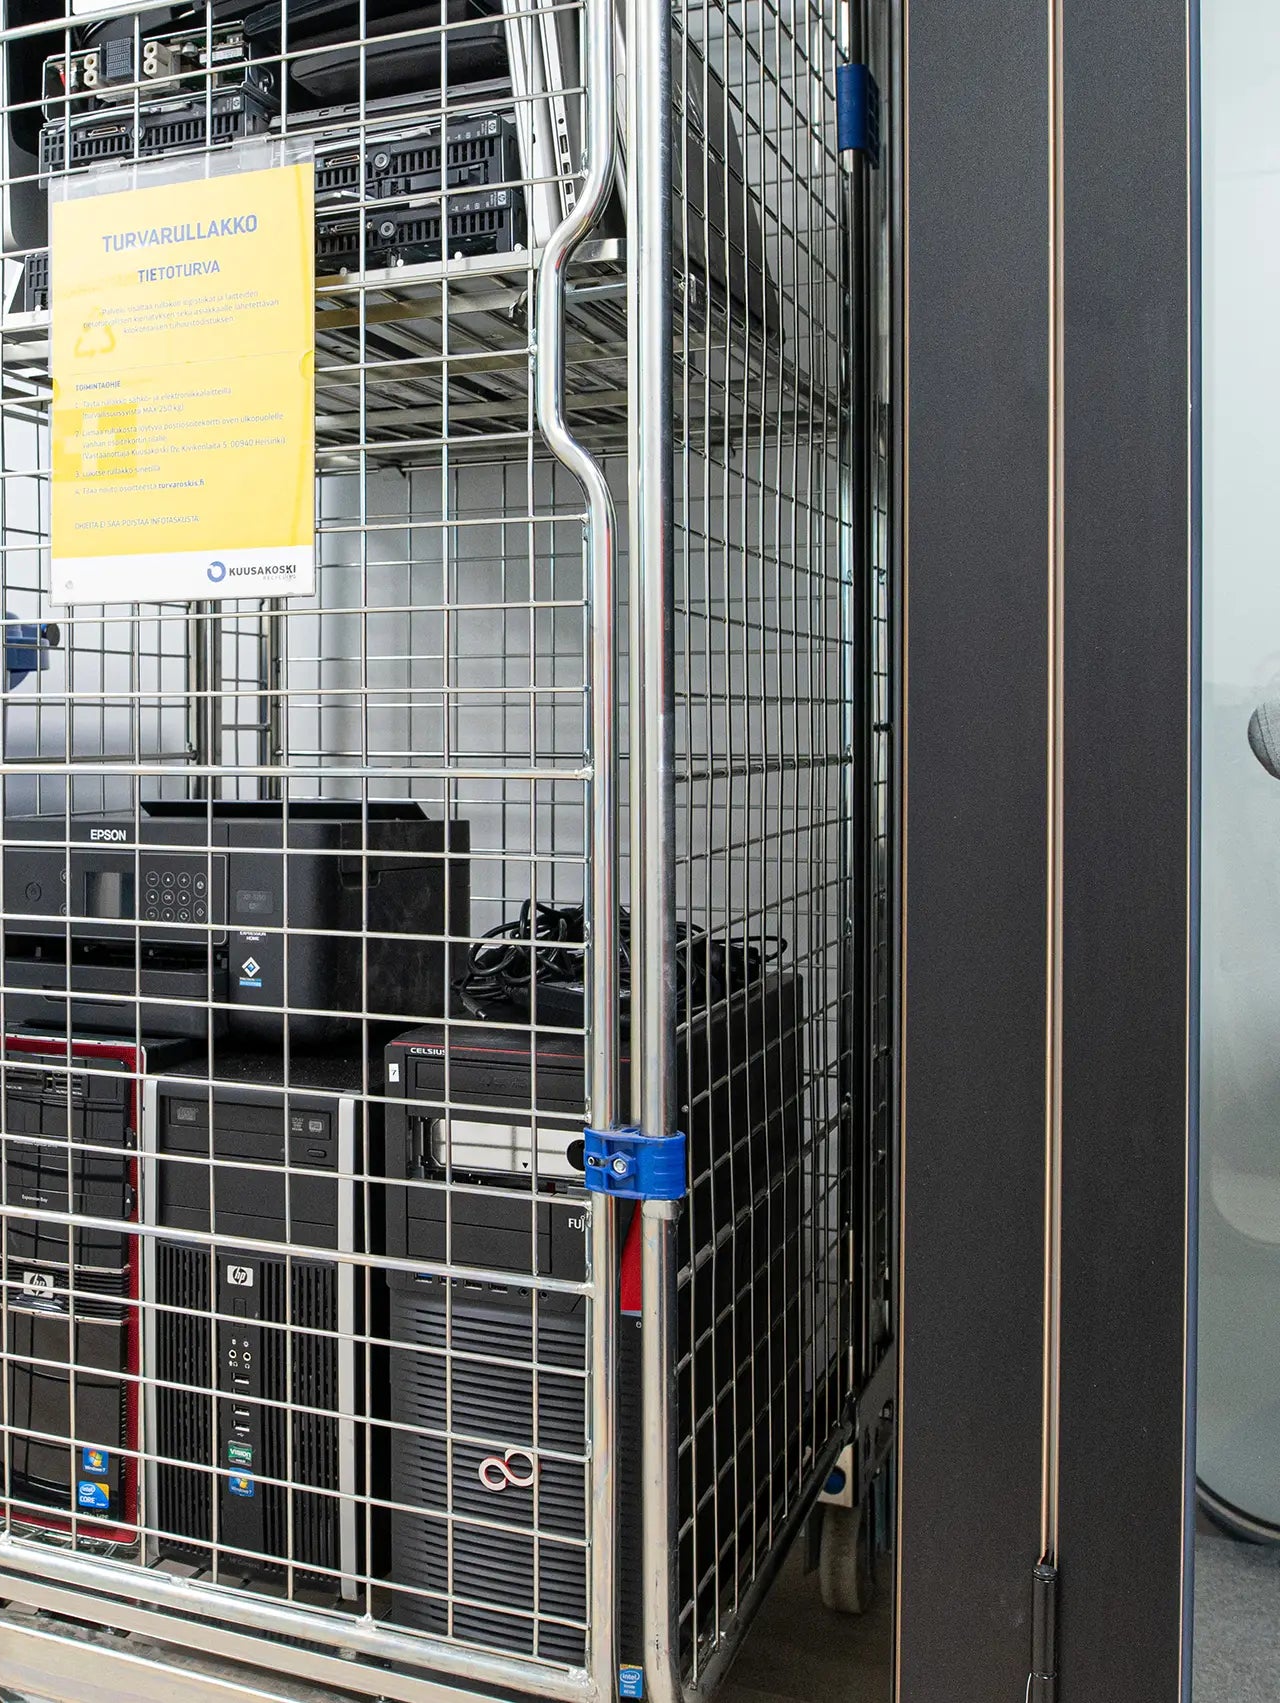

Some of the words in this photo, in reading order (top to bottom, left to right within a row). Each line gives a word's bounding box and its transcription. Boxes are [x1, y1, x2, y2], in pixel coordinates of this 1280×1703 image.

[102, 214, 258, 253] TURVARULLAKKO
[138, 260, 220, 283] TIETOTURVA
[158, 478, 204, 489] turvaroskis.fi
[229, 564, 296, 576] KUUSAKOSKI
[90, 830, 126, 841] EPSON
[80, 1496, 95, 1504] CORE
